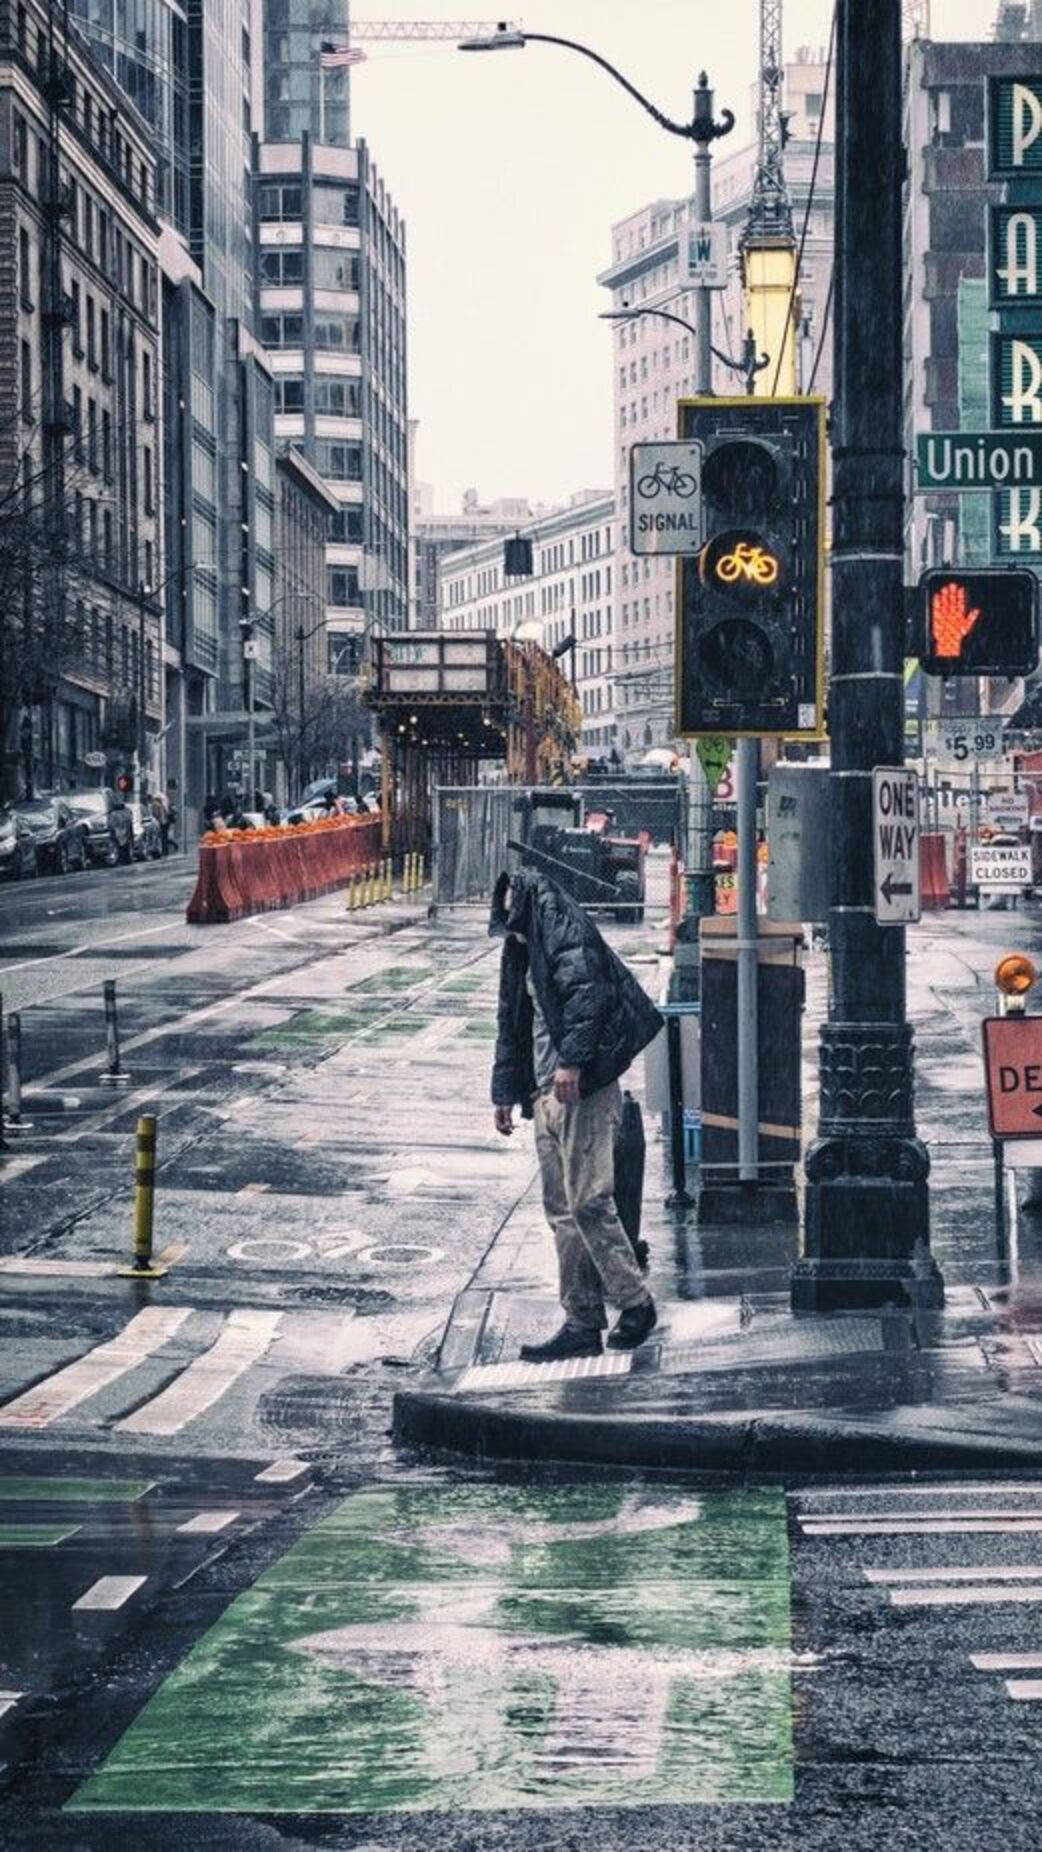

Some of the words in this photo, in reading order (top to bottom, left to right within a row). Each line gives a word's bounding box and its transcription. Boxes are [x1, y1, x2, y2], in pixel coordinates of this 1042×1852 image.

[928, 438, 1033, 480] Union
[638, 513, 698, 532] SIGNAL
[945, 734, 995, 761] $5.99
[879, 780, 914, 817] ONE
[879, 825, 915, 860] WAY
[974, 851, 1029, 862] SIDEWALK
[975, 867, 1028, 879] CLOSED
